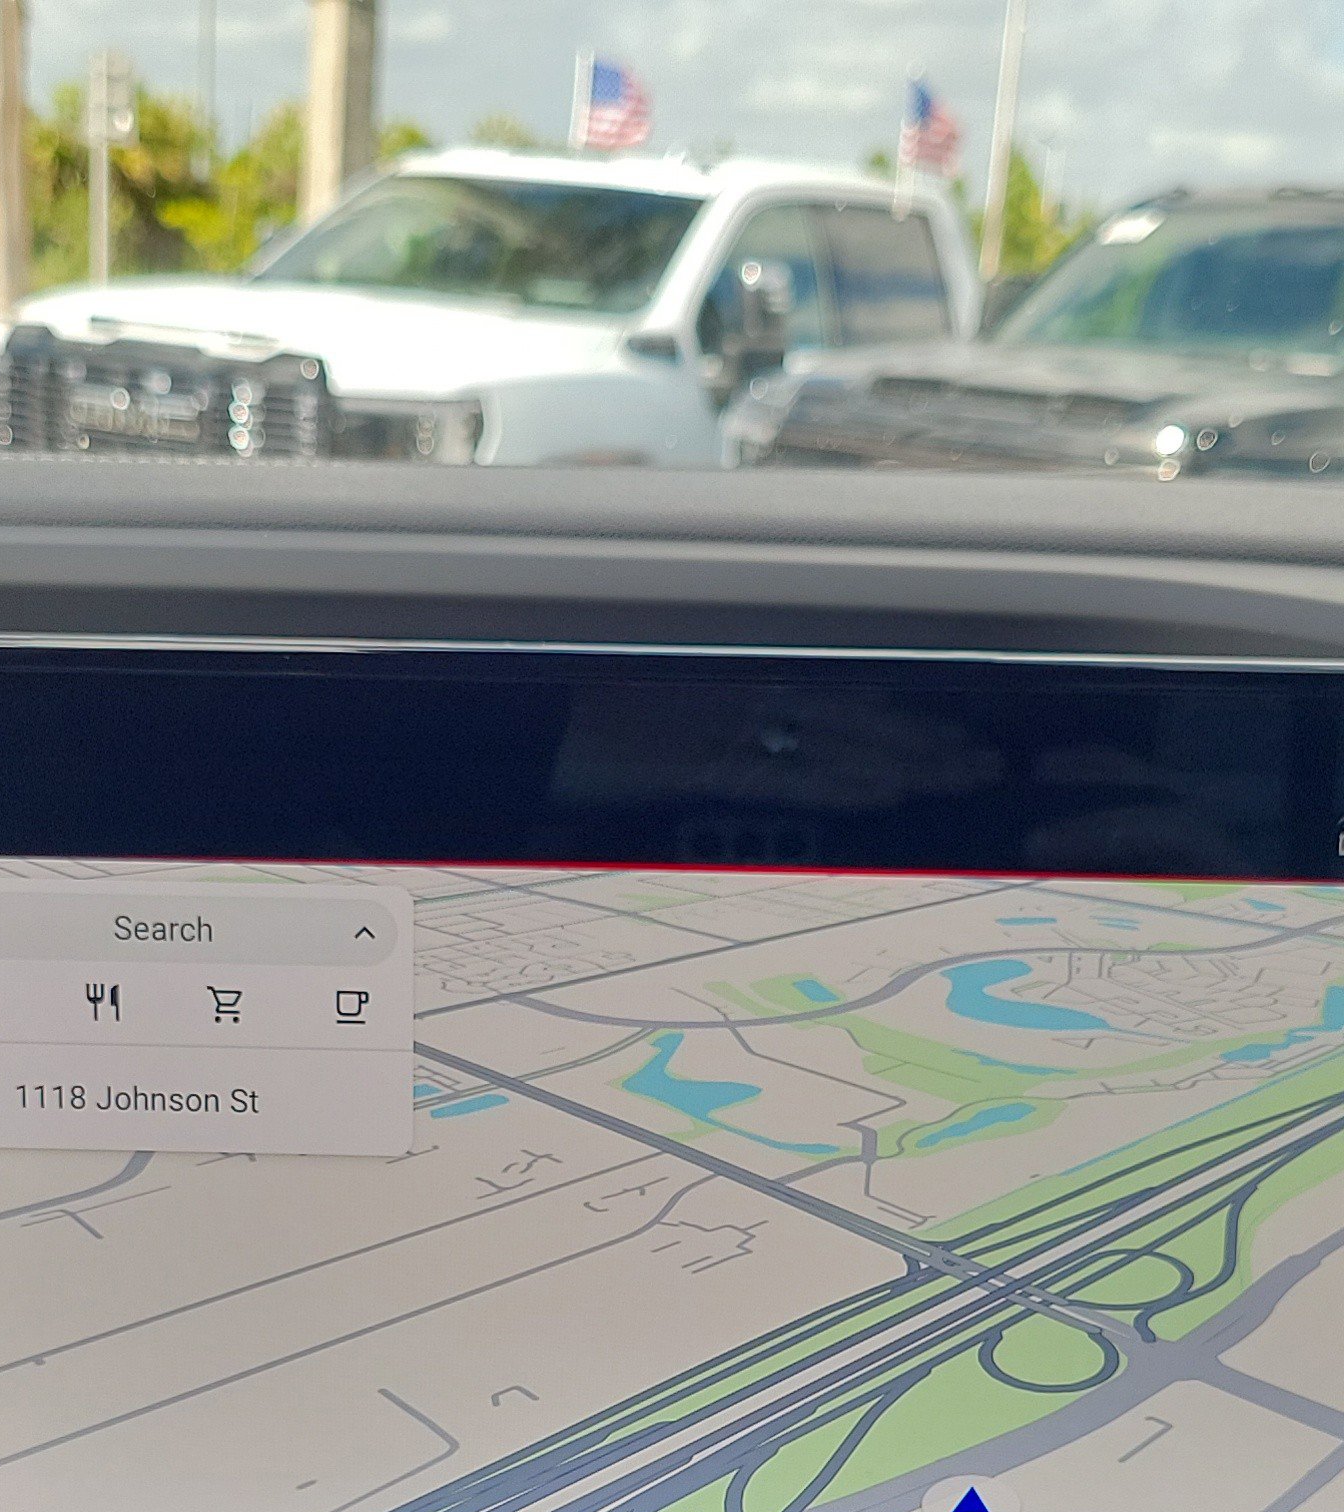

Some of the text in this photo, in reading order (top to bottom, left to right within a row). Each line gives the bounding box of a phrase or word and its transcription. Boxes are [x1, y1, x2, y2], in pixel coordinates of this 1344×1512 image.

[113, 914, 214, 943] Search
[16, 1083, 261, 1114] 1118 Johnson St
